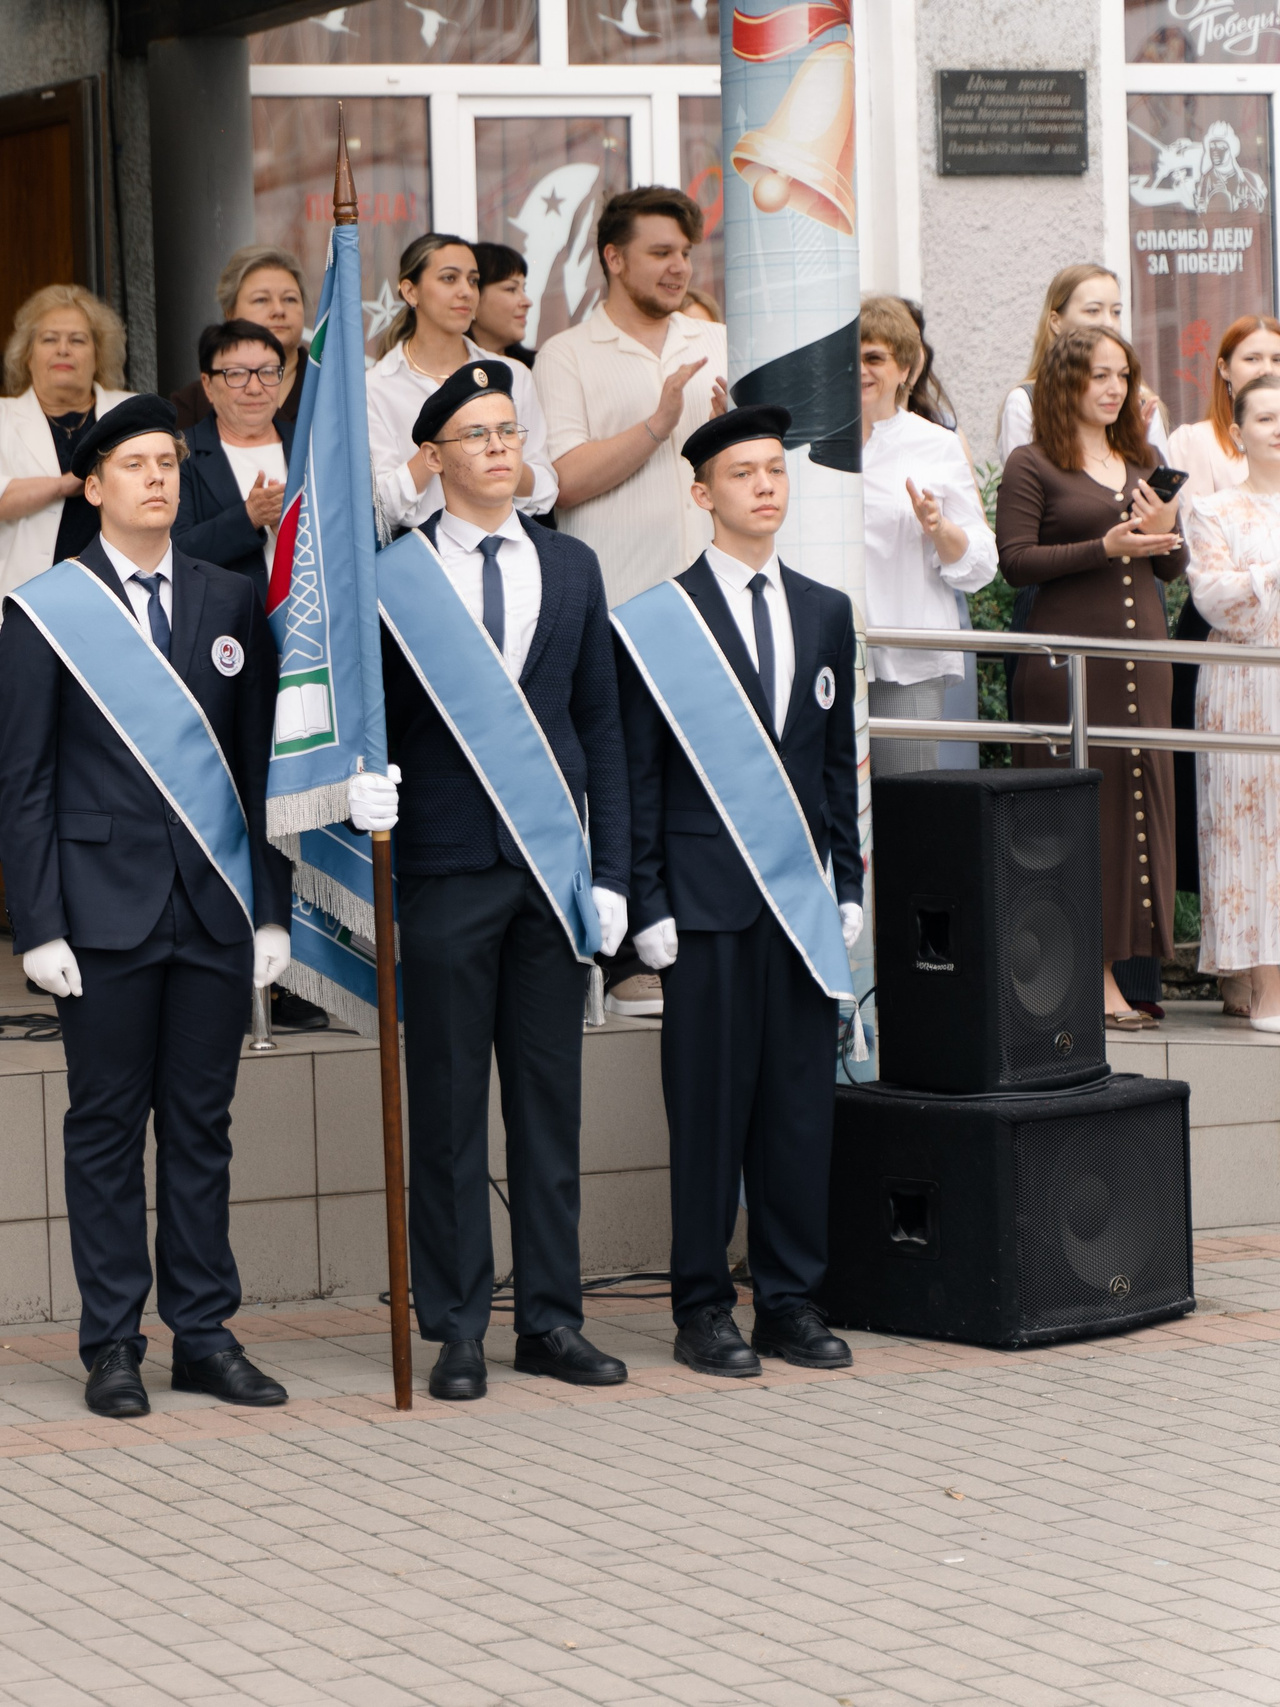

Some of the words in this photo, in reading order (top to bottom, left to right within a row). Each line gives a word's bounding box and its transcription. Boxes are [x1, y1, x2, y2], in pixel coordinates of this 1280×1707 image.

[305, 193, 417, 225] ПОЕДА!
[1136, 229, 1208, 251] СПАСИБО
[1212, 227, 1254, 252] ДЕДУ
[1147, 253, 1169, 275] ЗА
[1177, 251, 1244, 275] ПОБЕДУ!
